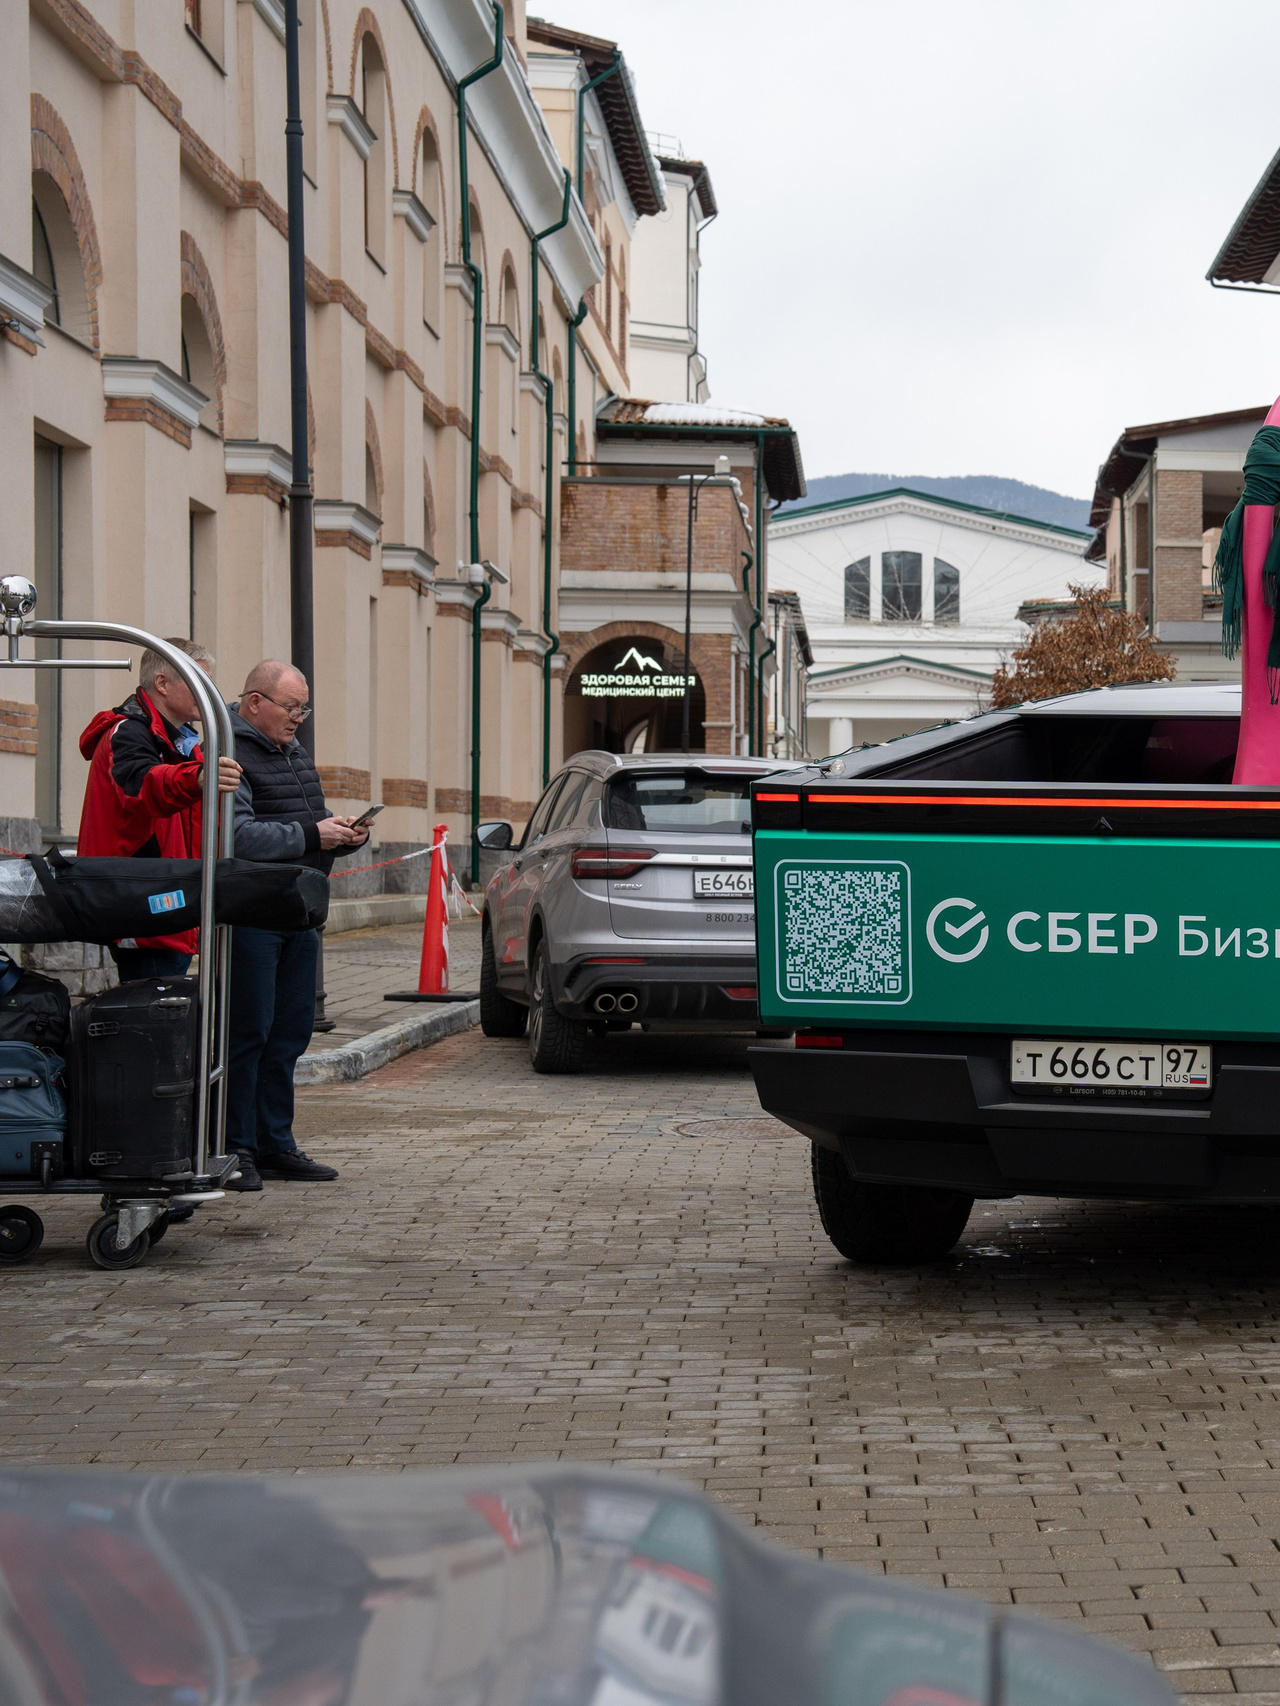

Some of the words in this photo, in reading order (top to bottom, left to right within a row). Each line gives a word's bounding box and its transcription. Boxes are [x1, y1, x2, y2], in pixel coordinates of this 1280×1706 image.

[580, 674, 650, 686] ЗДОРОВАЯ
[652, 675, 696, 686] СЕМЬЯ
[581, 686, 655, 697] МЕДИЦИНСКИЙ
[613, 883, 643, 891] GEELY
[706, 913, 712, 922] 8
[715, 913, 734, 922] 800
[1006, 911, 1159, 954] СБЕР
[1166, 1048, 1198, 1073] 97
[1165, 1073, 1189, 1083] RUS
[1069, 1087, 1095, 1095] Larson
